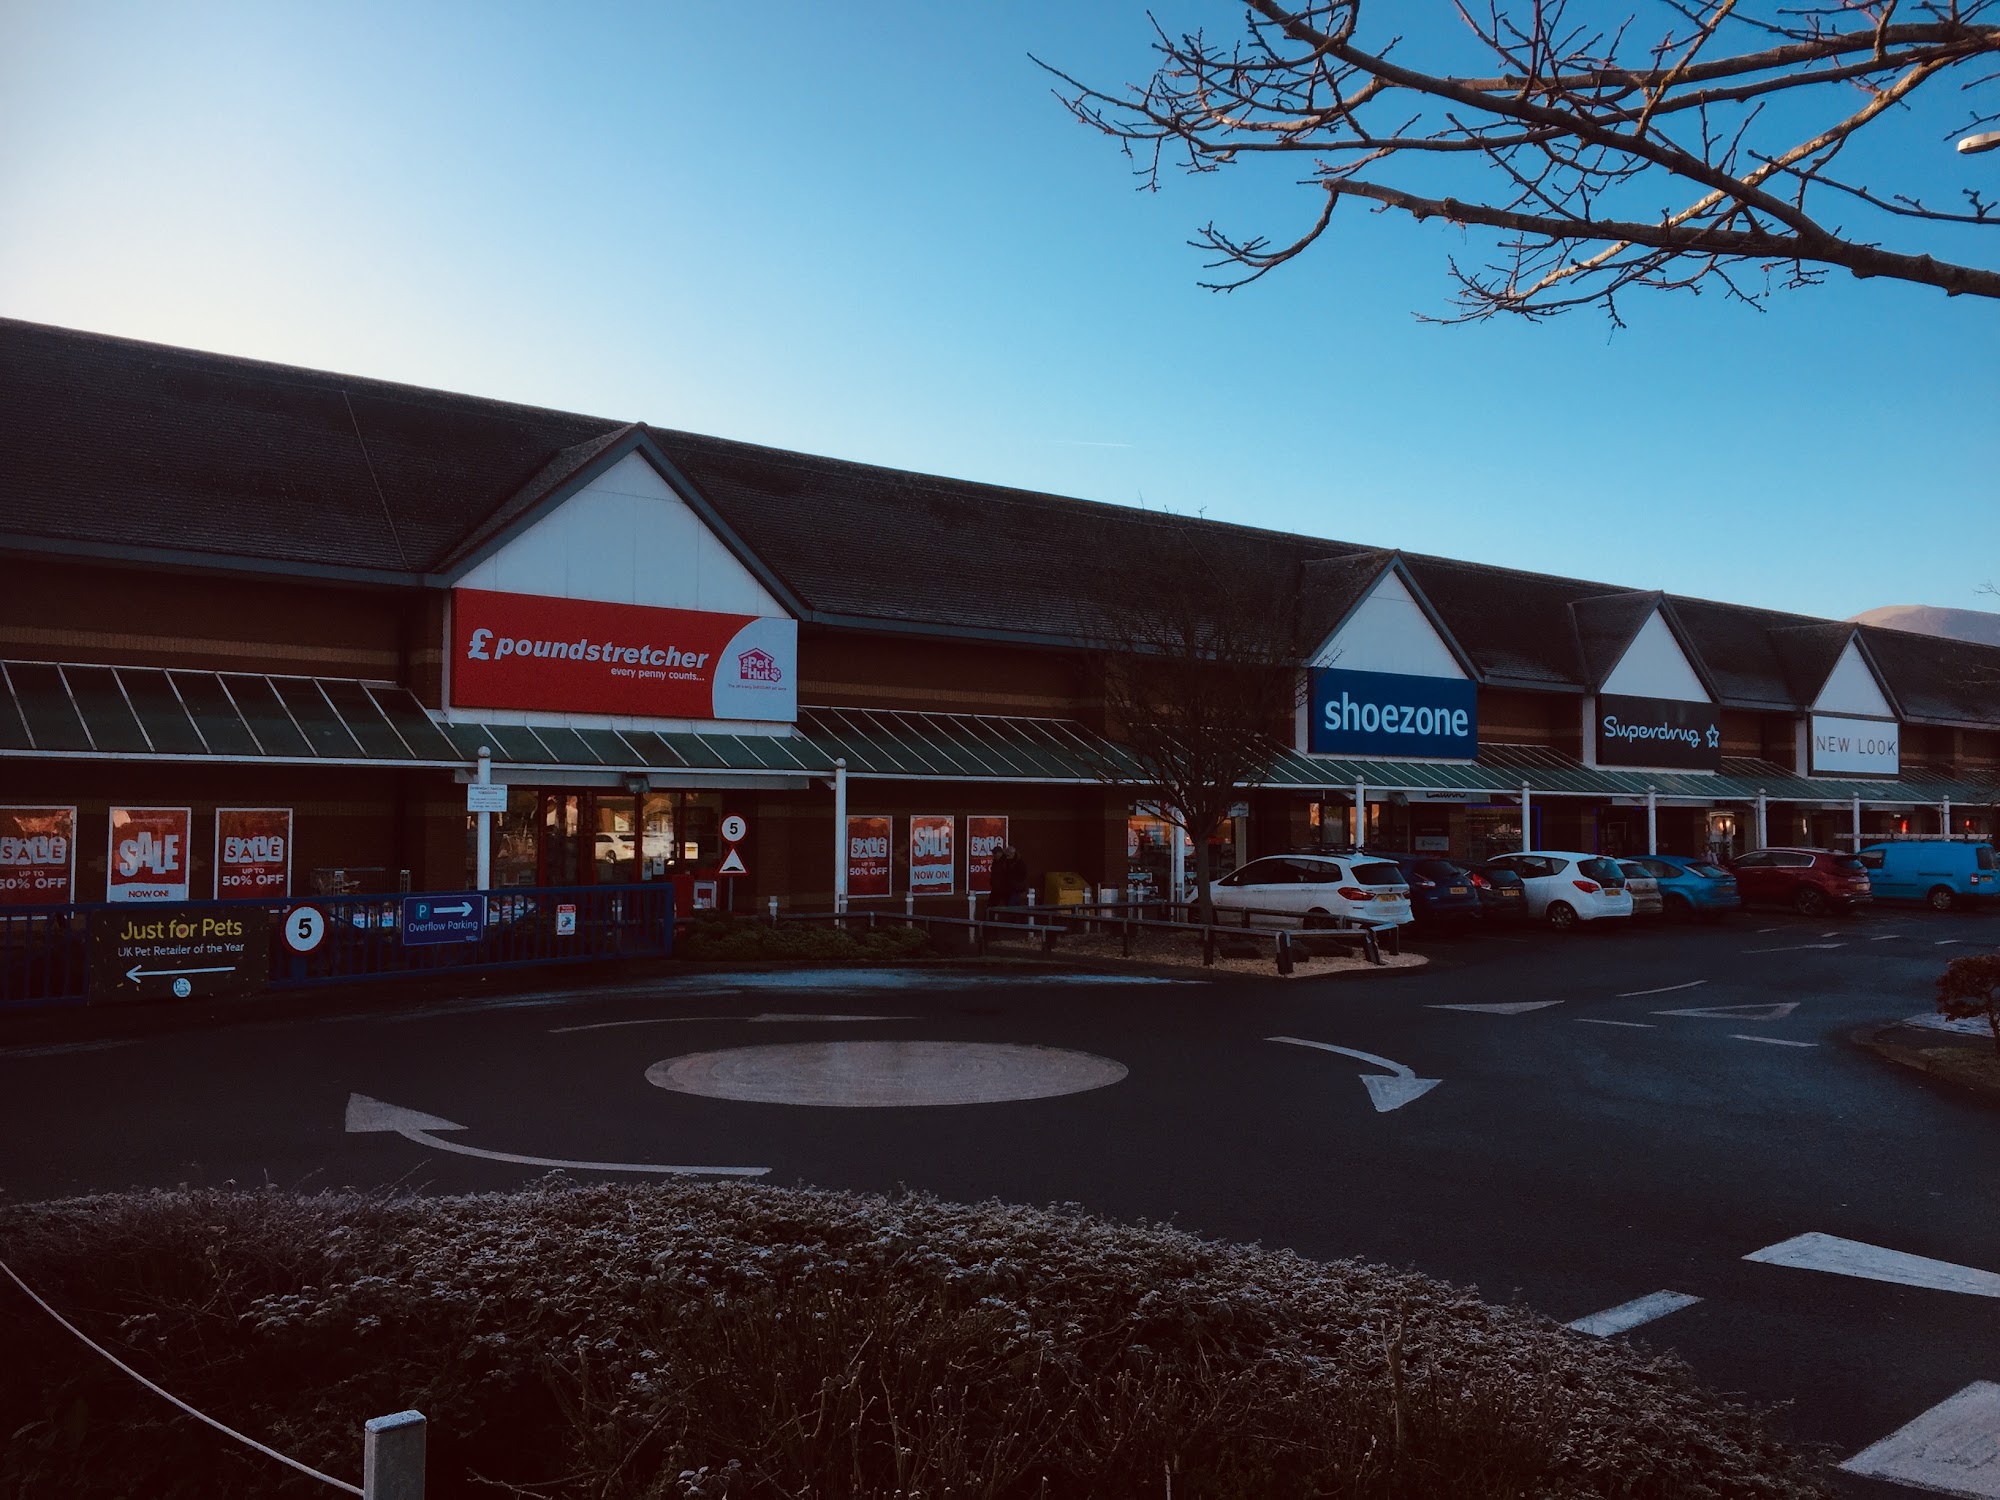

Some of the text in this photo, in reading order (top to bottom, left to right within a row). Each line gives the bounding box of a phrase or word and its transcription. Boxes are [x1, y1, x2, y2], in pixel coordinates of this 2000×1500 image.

[748, 656, 770, 669] Pet
[611, 666, 705, 682] every penny counts...
[748, 668, 770, 680] Hut
[1324, 692, 1469, 737] shoezone
[1603, 715, 1701, 749] Superdrug
[1815, 735, 1896, 757] NEW LOOK
[730, 822, 738, 835] 5
[914, 826, 950, 858] SALE
[119, 831, 179, 877] SALE
[242, 867, 265, 875] UP TO
[914, 871, 950, 880] NOW ON!
[35, 878, 67, 889] OFF
[222, 875, 284, 887] 50% OFF
[128, 889, 169, 898] NOW ON!
[419, 905, 427, 917] P
[120, 918, 243, 940] Just for Pets
[298, 918, 312, 939] 5
[408, 920, 478, 932] Overflow Parking
[118, 942, 244, 957] UK Pet Retailer of the Year
